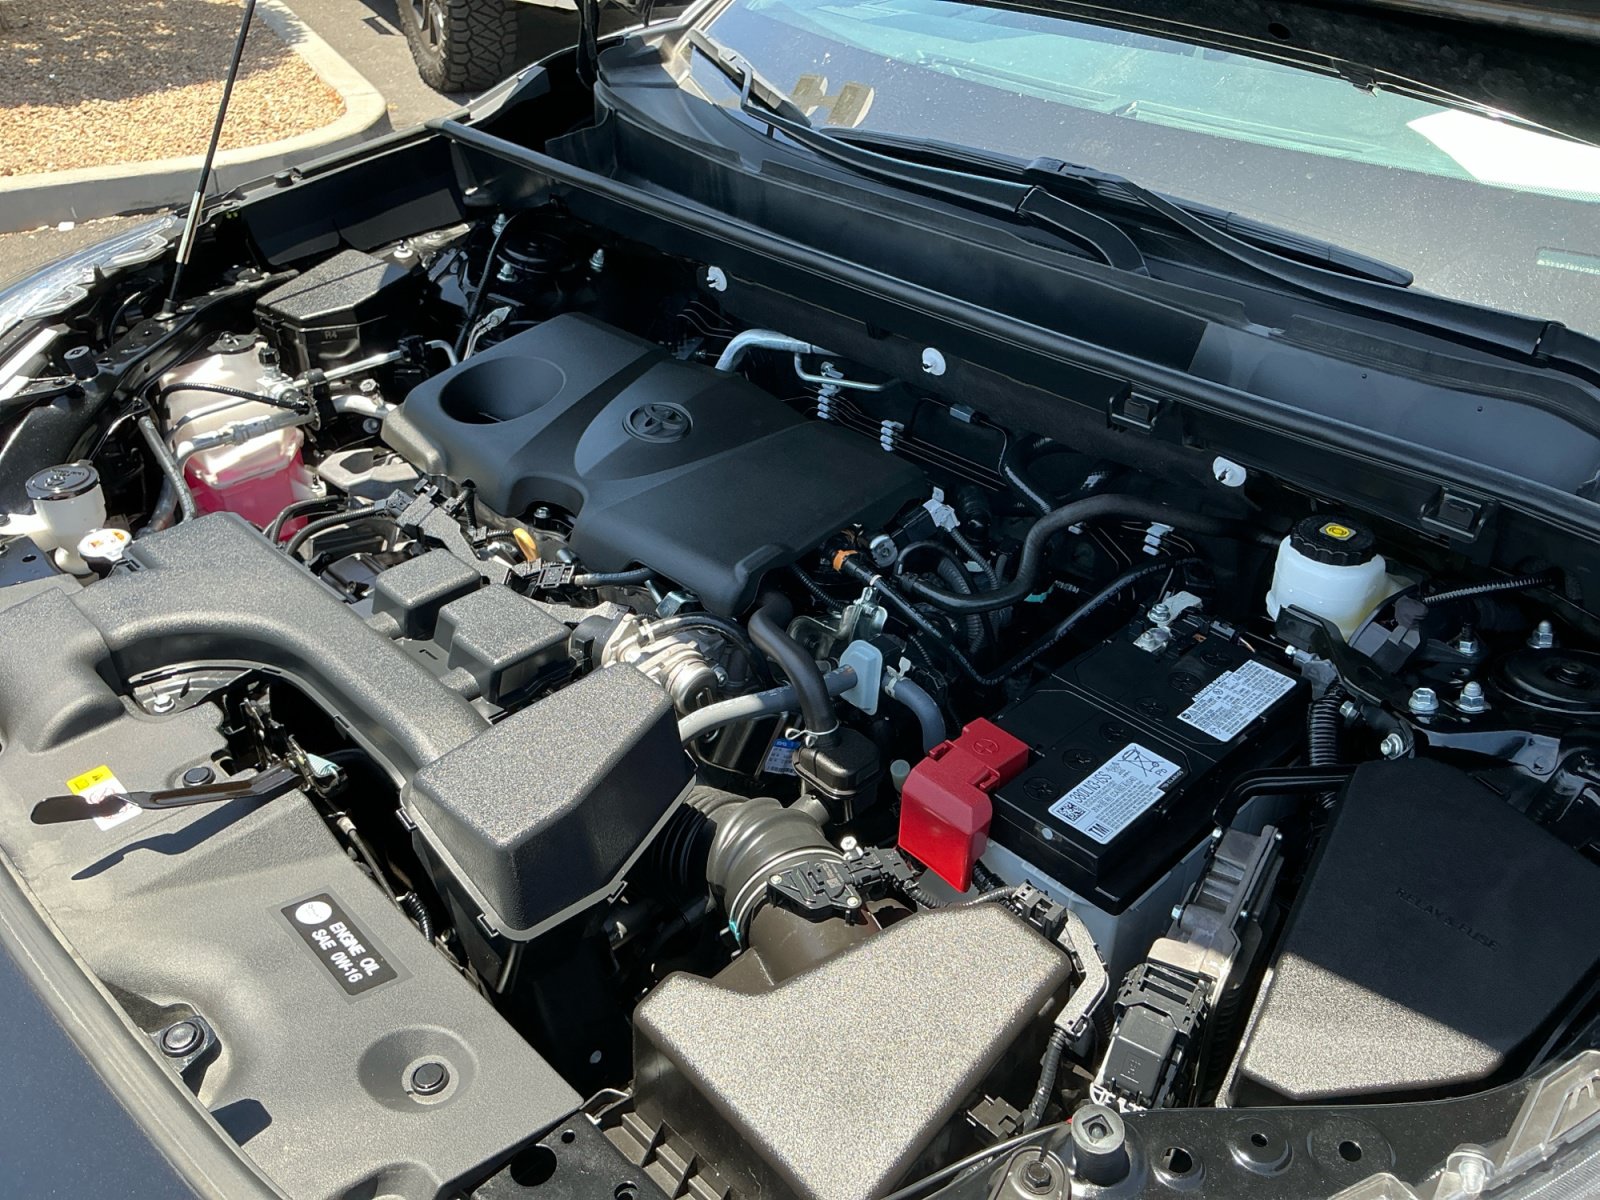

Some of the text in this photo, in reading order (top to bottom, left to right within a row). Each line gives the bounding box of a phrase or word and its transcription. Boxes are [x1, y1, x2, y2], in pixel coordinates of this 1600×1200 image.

[1088, 823, 1110, 838] TM
[1396, 887, 1444, 918] RELAY
[1458, 923, 1499, 952] FUSE
[311, 929, 337, 951] SAE
[330, 951, 364, 983] 0W-16
[329, 921, 380, 977] ENGINE OIL
